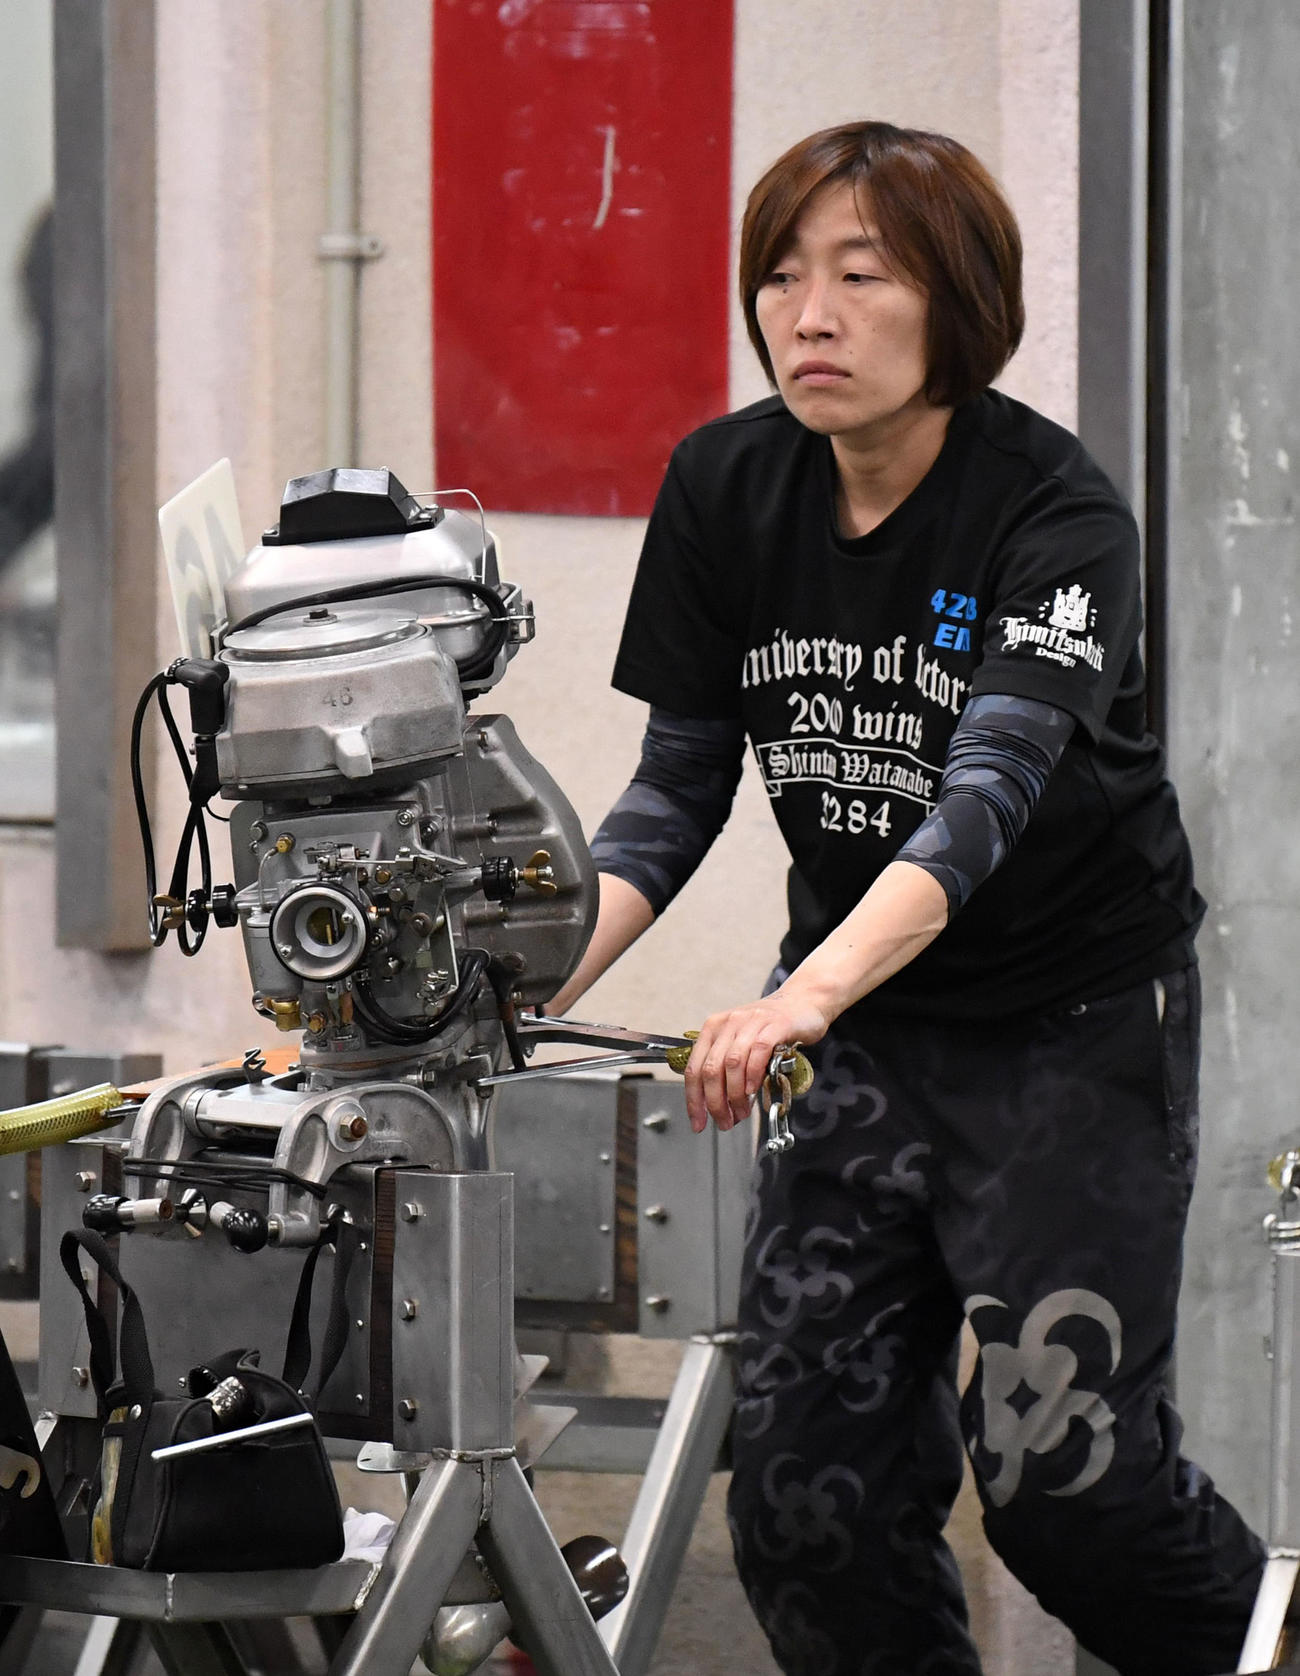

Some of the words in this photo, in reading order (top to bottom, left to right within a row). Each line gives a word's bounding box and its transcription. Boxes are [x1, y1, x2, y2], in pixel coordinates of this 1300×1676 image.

[873, 635, 907, 684] of
[1035, 647, 1077, 668] Design
[787, 691, 843, 735] 200
[852, 701, 923, 750] wins
